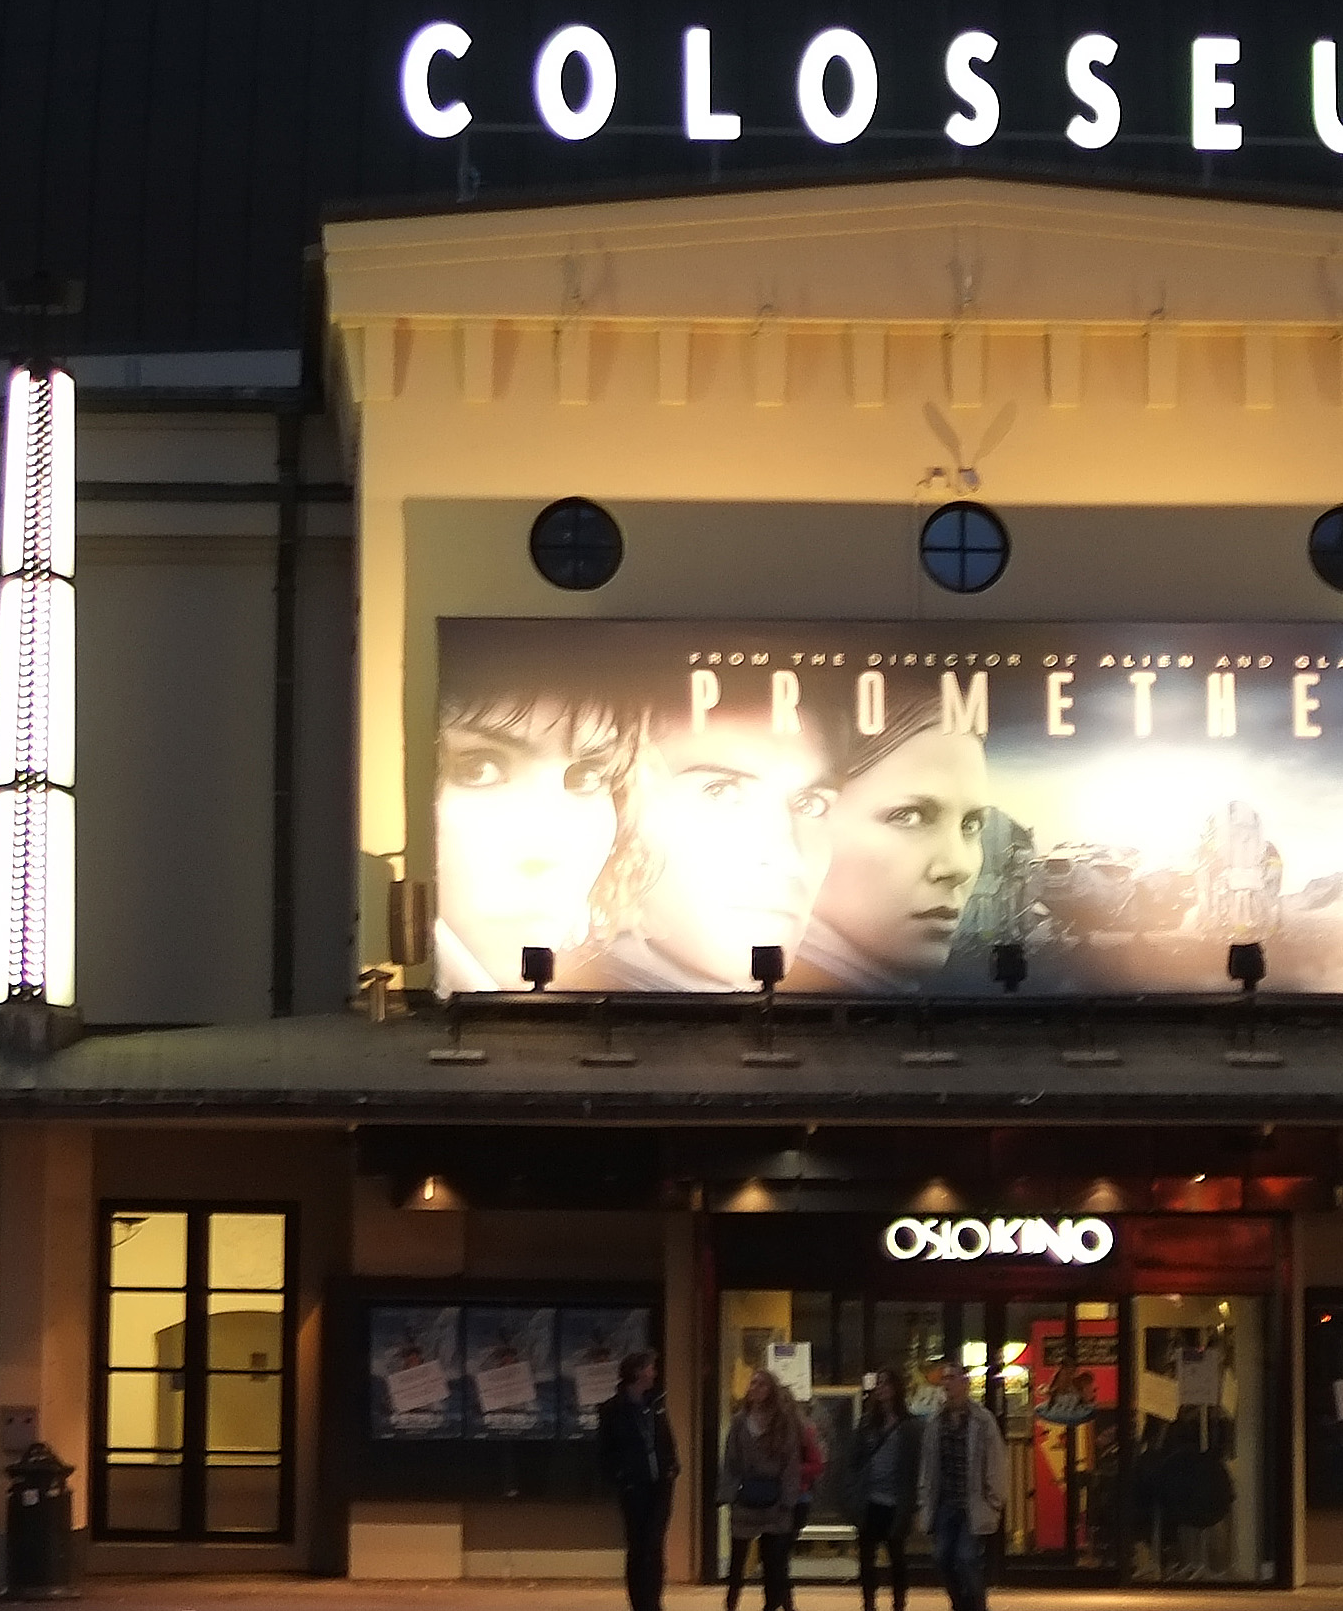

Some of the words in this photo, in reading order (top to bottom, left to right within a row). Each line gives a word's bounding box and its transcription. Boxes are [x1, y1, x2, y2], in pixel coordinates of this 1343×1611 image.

[688, 651, 770, 666] FROM
[791, 652, 846, 667] THE
[867, 653, 1022, 668] DIRECTOR
[1042, 653, 1078, 668] OF
[1099, 654, 1194, 669] ALIEN
[1215, 654, 1274, 670] AND
